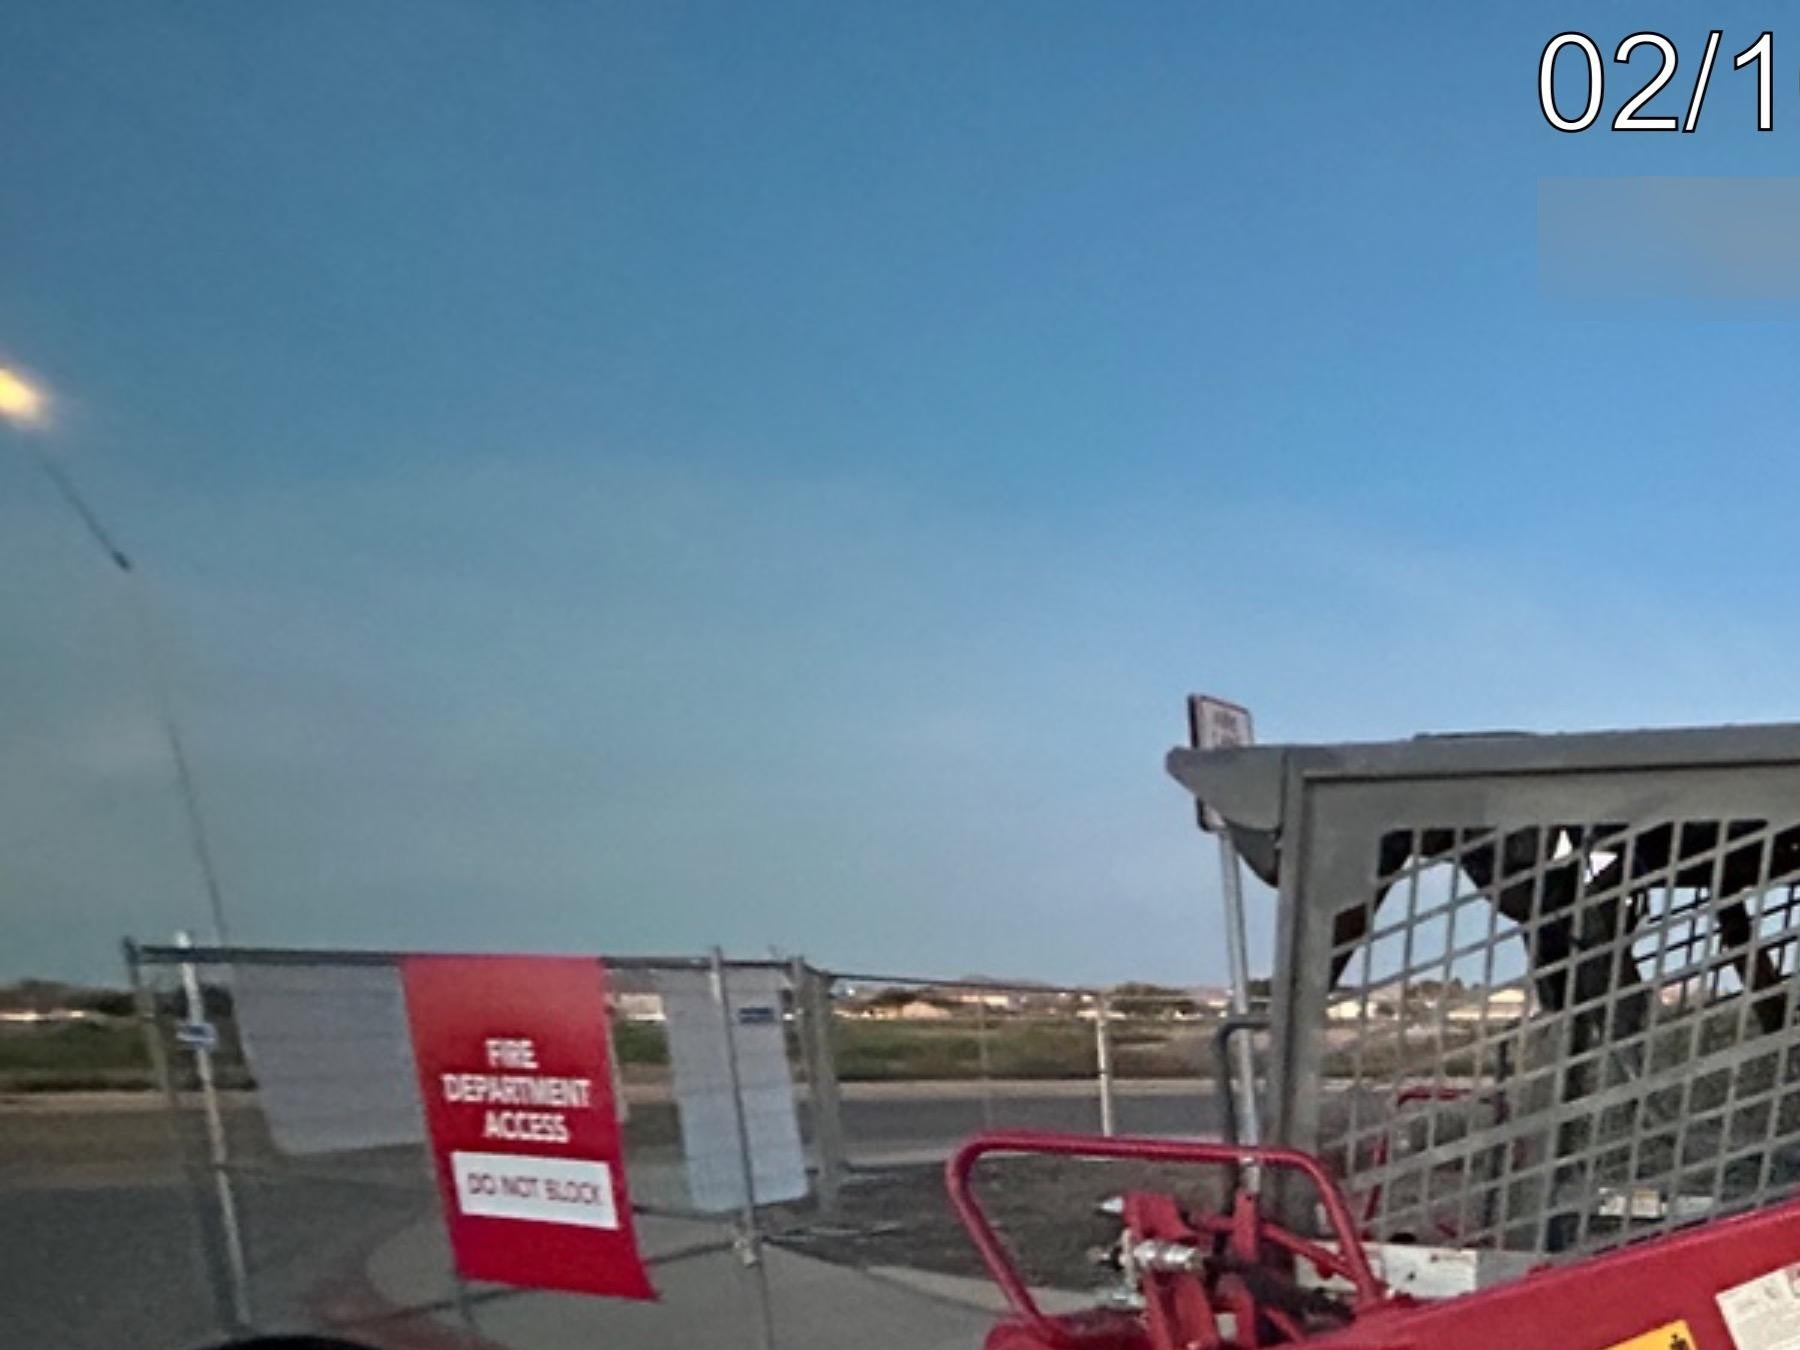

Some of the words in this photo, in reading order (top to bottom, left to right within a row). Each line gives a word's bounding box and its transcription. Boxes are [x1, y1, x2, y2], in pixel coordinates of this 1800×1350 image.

[485, 1038, 540, 1069] FIRE
[441, 1074, 592, 1108] DEPARTMENT
[482, 1111, 571, 1144] ACCESS
[467, 1173, 496, 1195] DO
[501, 1176, 538, 1198] NOT
[545, 1179, 602, 1205] BLOCK
